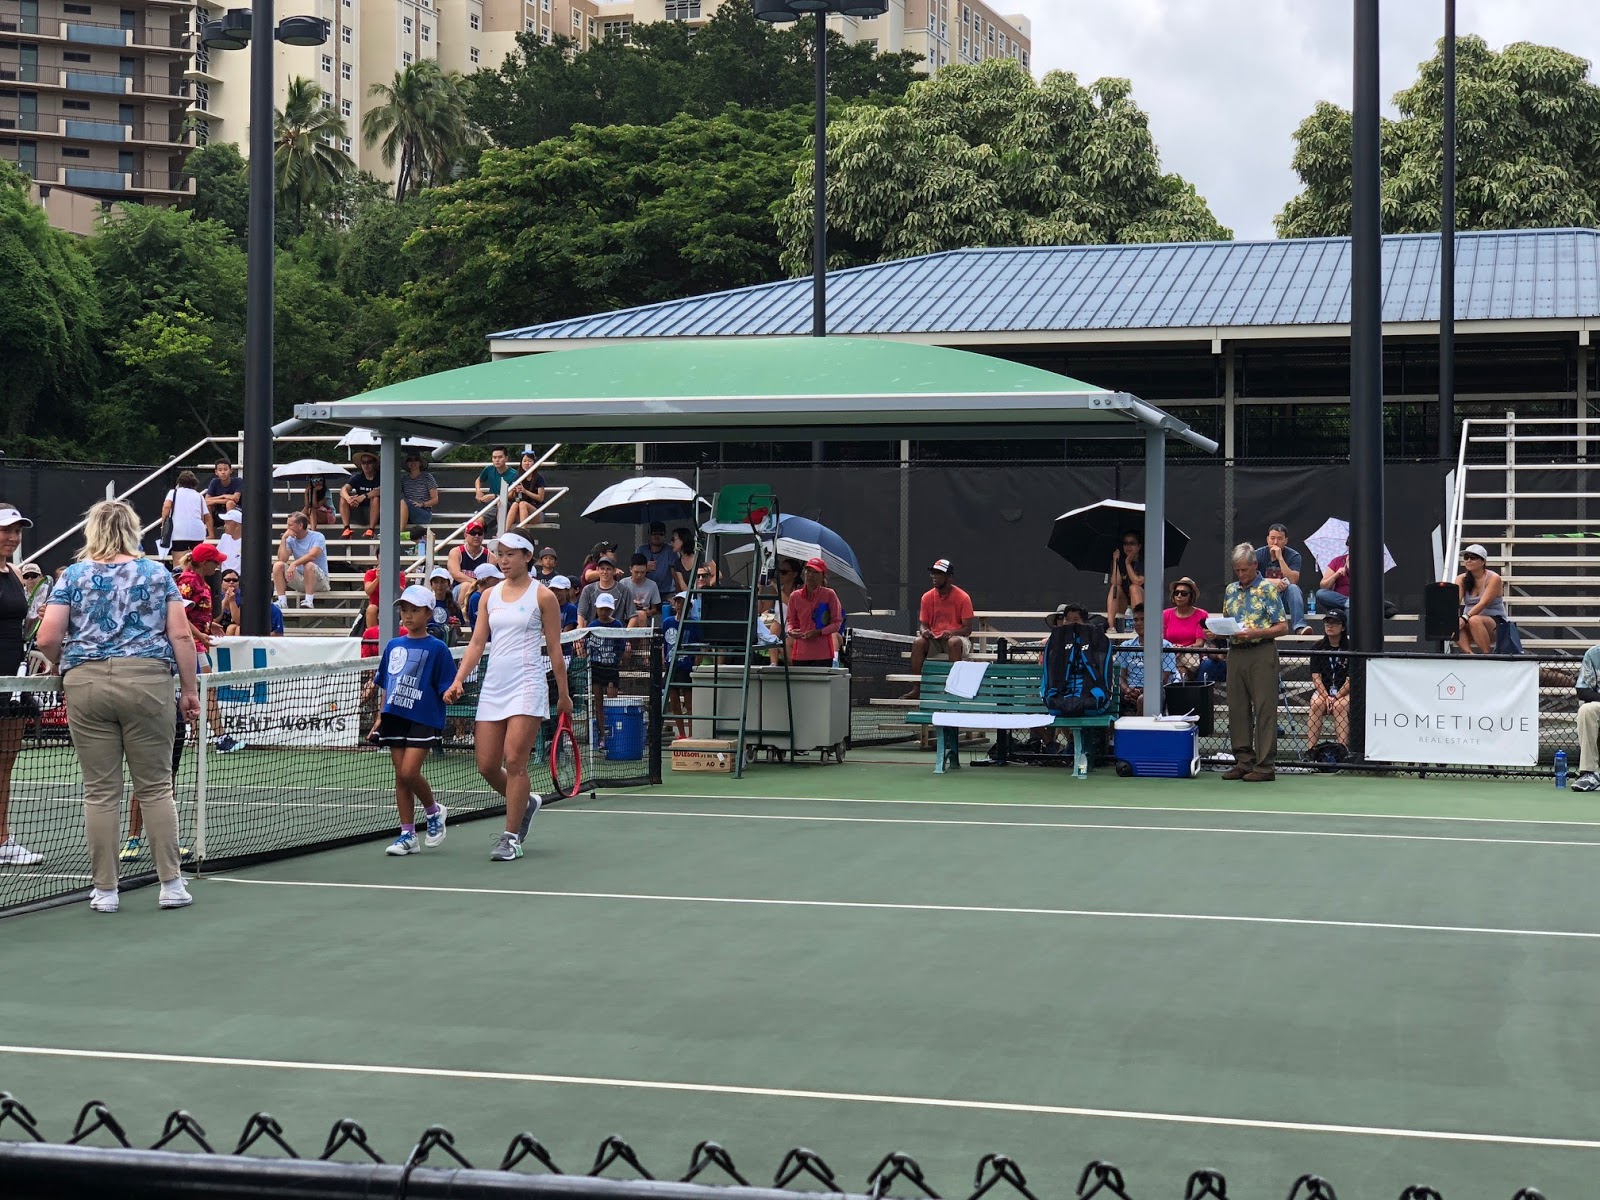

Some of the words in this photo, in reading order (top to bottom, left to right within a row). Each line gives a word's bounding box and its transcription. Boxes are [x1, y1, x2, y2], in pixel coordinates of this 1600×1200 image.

[402, 674, 417, 687] NEXT
[393, 695, 415, 709] GREATS
[280, 716, 346, 732] WORKS
[1374, 713, 1529, 732] HOMETIQUE
[1418, 736, 1441, 744] REAL
[1445, 737, 1480, 745] ESTATE
[673, 750, 700, 758] Wilson
